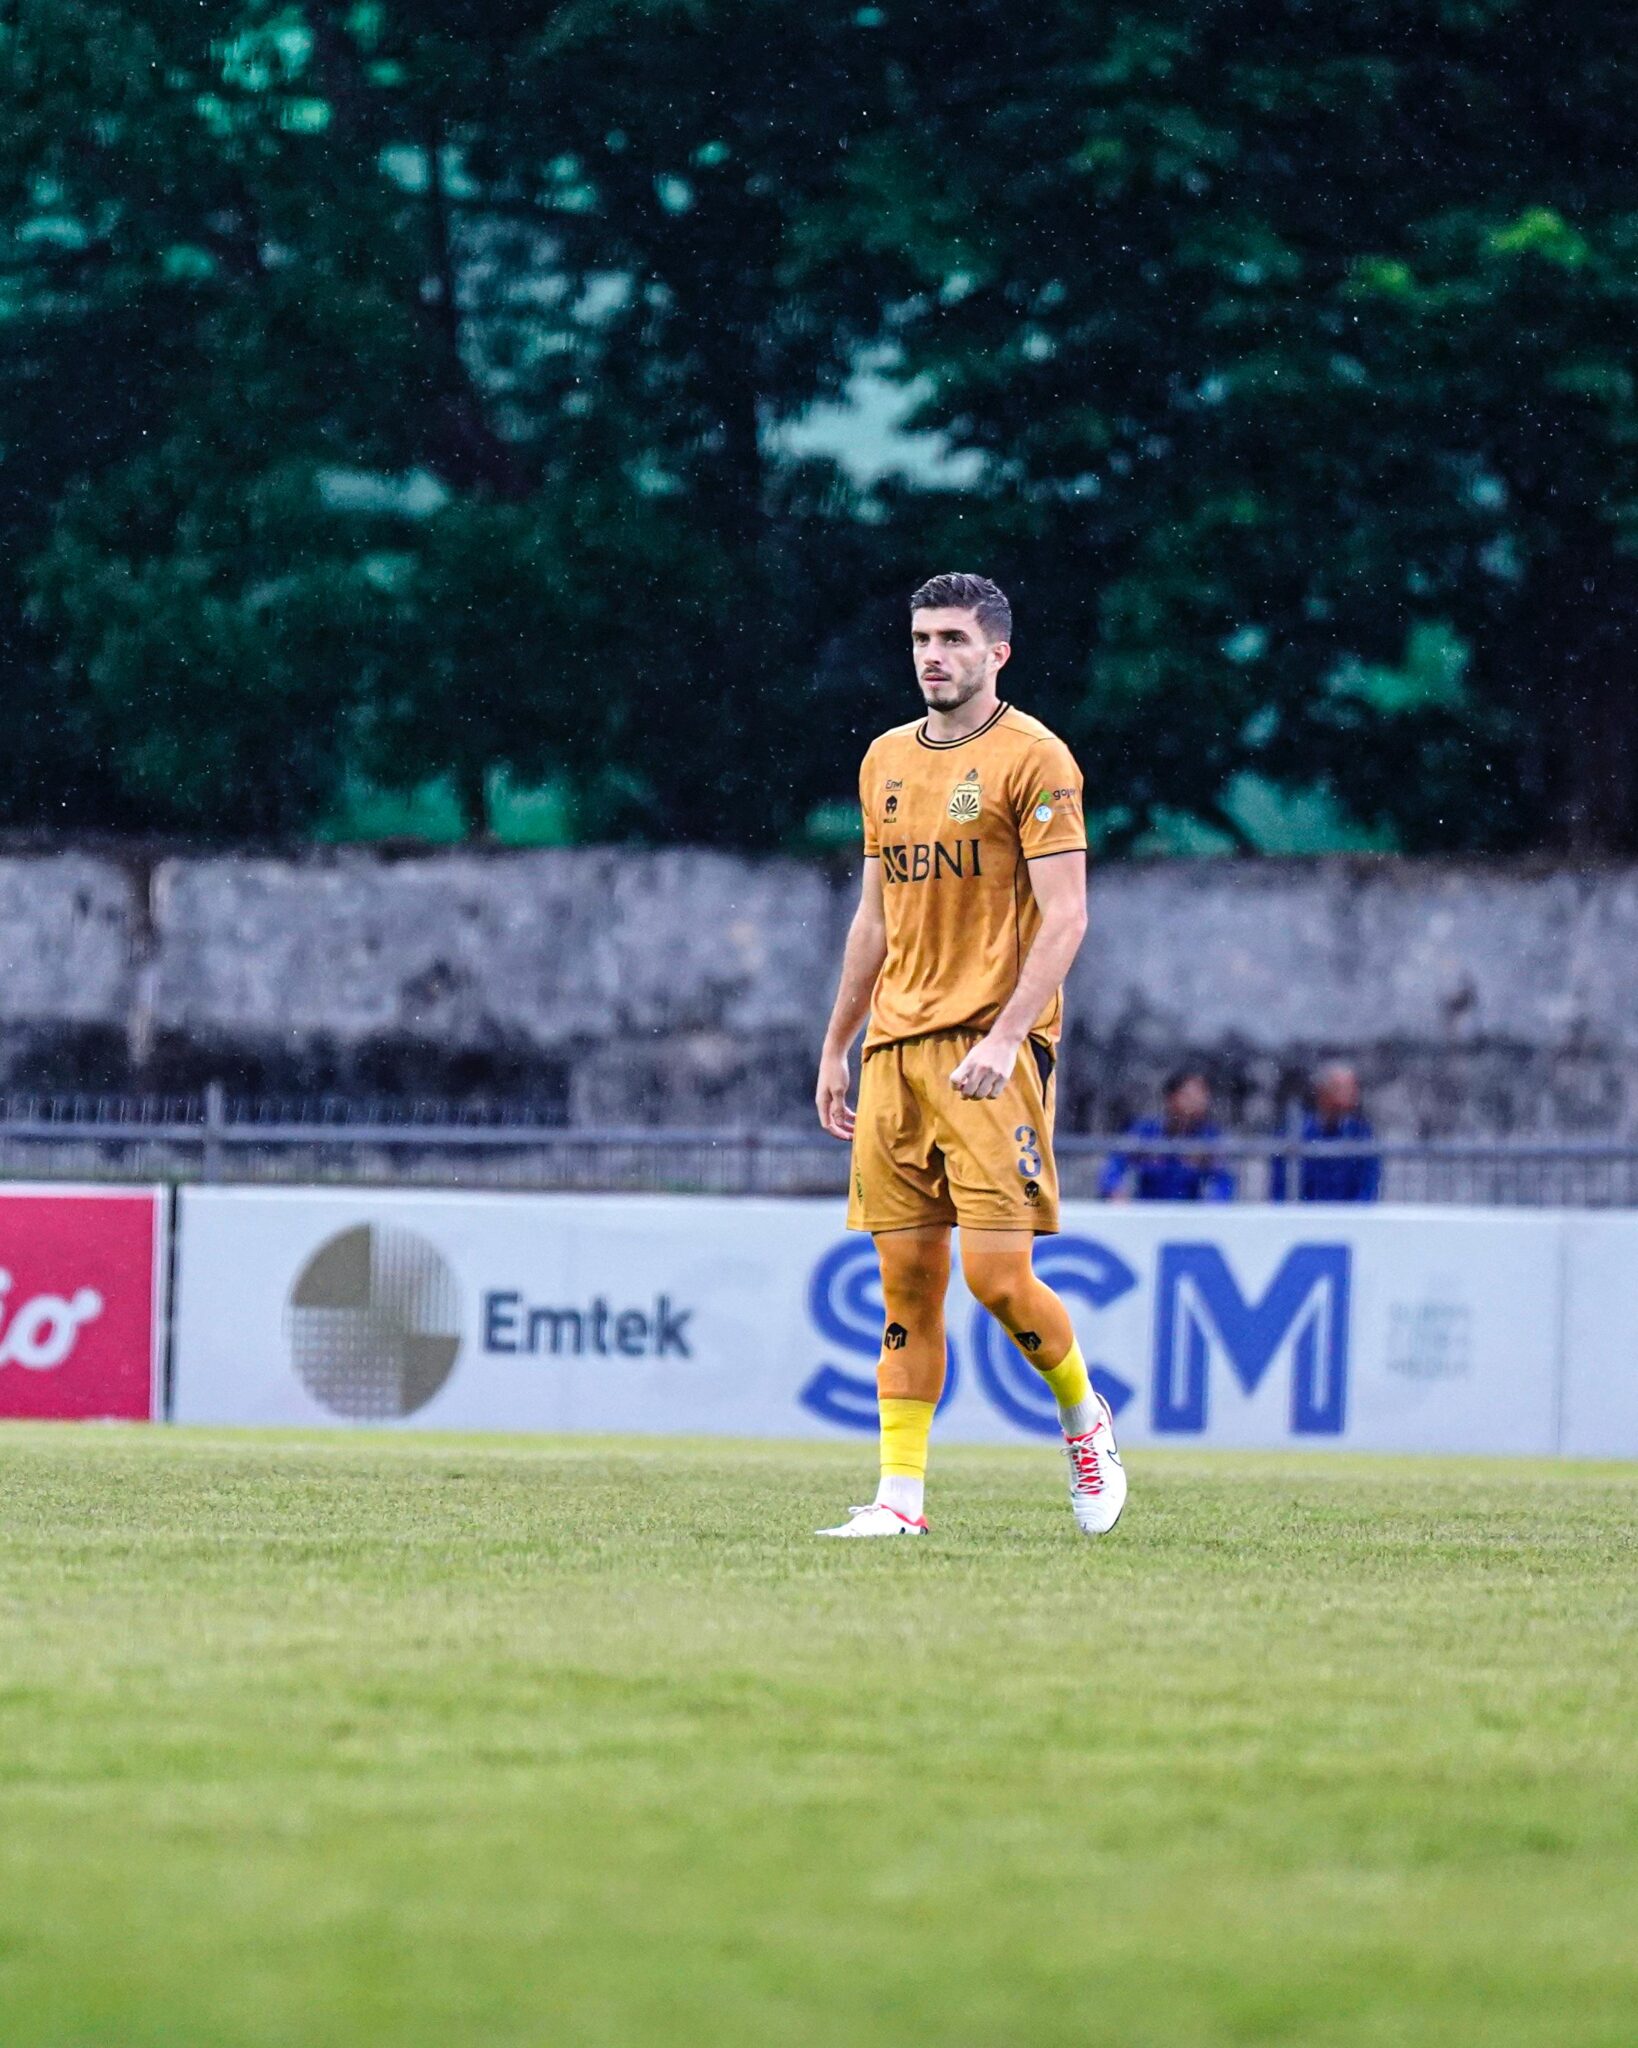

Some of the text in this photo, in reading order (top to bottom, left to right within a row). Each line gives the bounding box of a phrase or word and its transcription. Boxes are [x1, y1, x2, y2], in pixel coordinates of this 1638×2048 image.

[912, 839, 982, 881] BNI
[1014, 1125, 1042, 1178] 3
[482, 1290, 693, 1359] Emtek
[800, 1234, 1354, 1437] SCM
